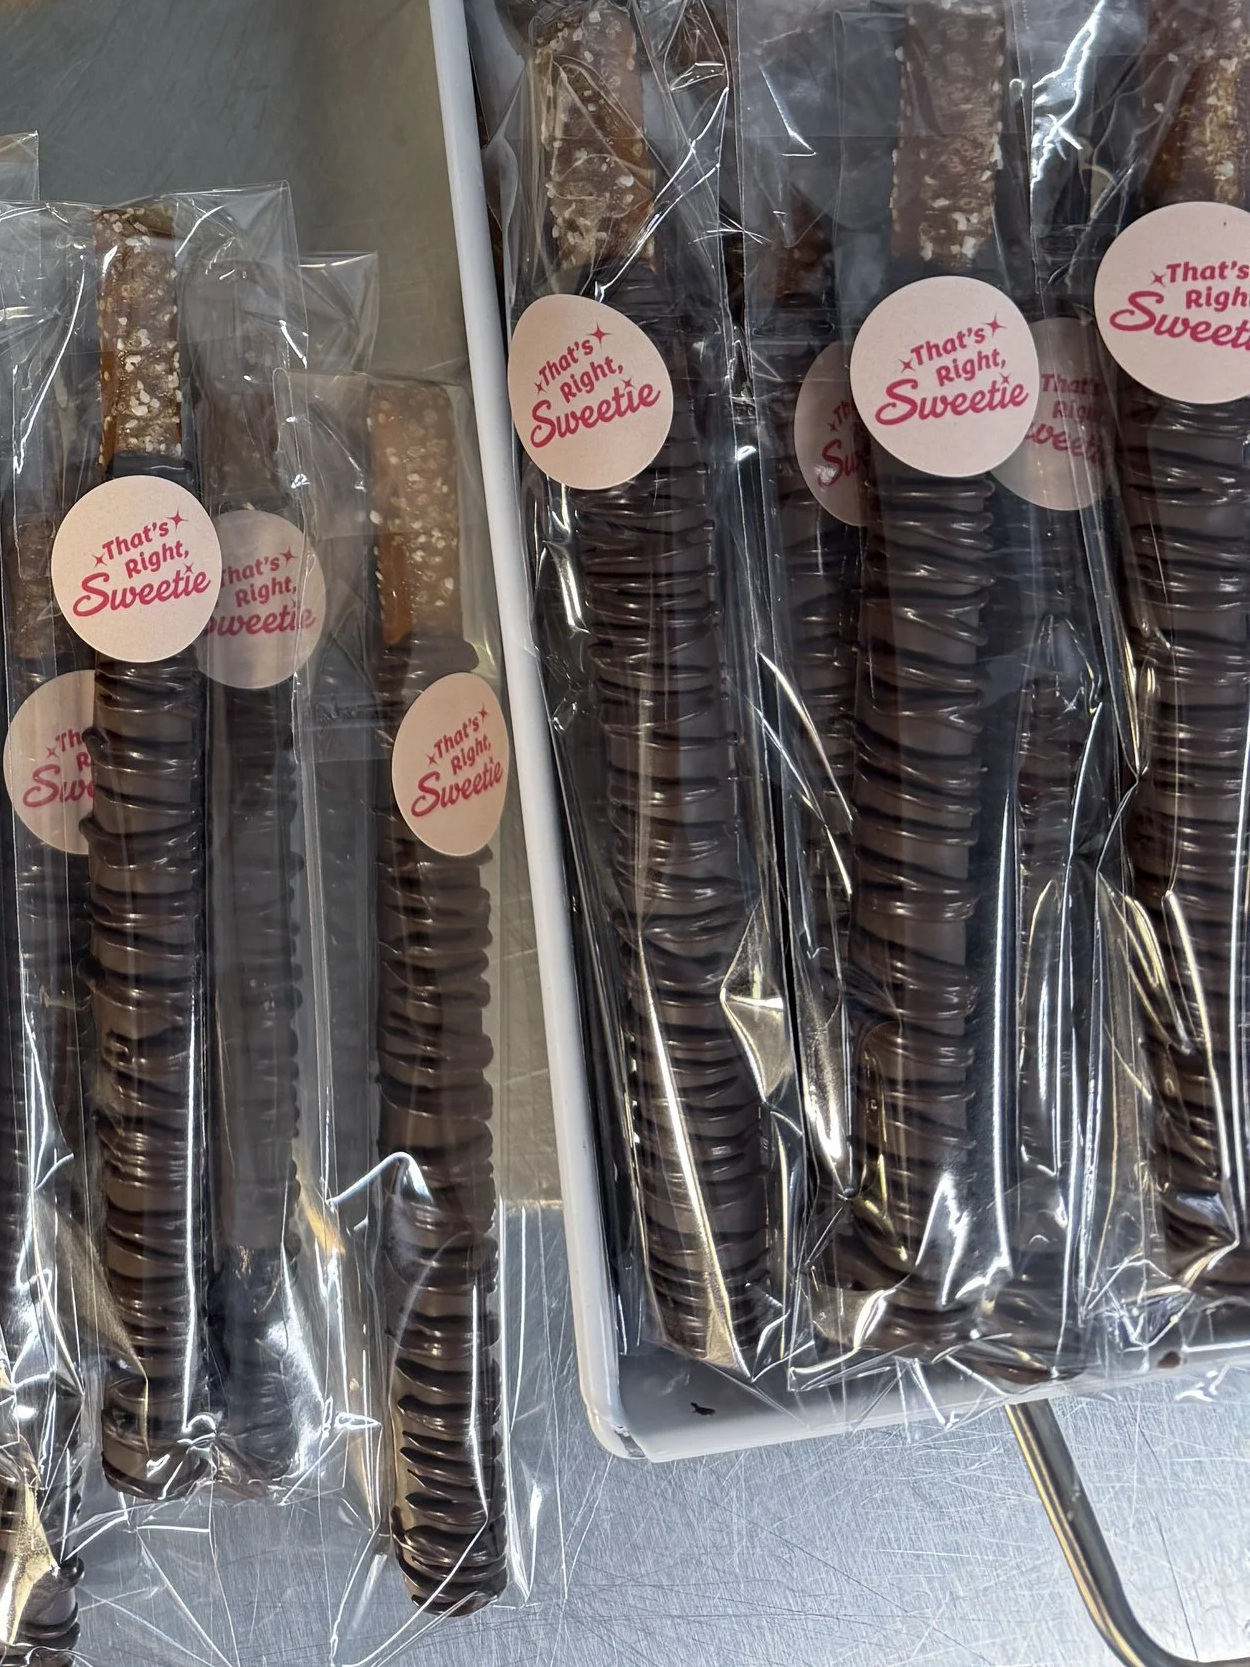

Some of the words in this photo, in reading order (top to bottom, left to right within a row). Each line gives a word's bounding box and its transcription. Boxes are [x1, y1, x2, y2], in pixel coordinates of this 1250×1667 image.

[1166, 260, 1250, 284] That's
[1186, 286, 1250, 312] Righ
[1110, 291, 1250, 351] Sweet
[538, 337, 595, 387] That's
[910, 326, 985, 367] That's
[935, 348, 1006, 387] Right,
[559, 357, 624, 404] Right,
[875, 378, 1028, 425] Sweetie
[531, 382, 661, 448] Sweetie
[102, 521, 169, 560] That's
[125, 540, 189, 579] Right,
[72, 570, 211, 617] Sweetie
[235, 577, 297, 608] Right,
[204, 605, 316, 637] weetie
[434, 715, 479, 759] That's
[451, 733, 491, 776] Right,
[410, 760, 504, 818] Sweetie
